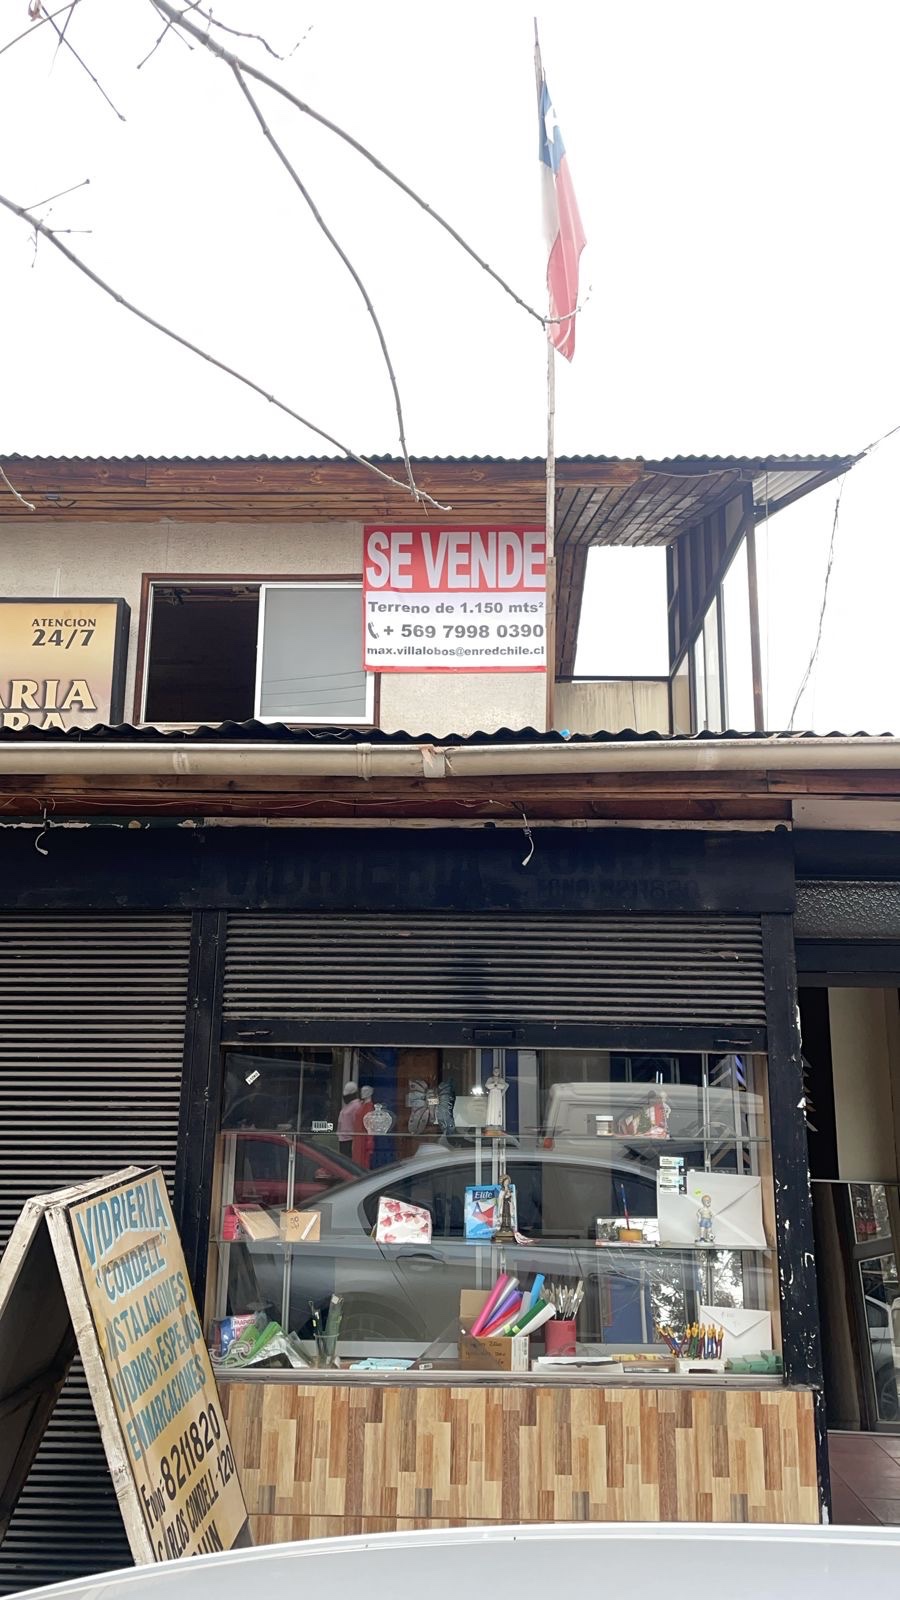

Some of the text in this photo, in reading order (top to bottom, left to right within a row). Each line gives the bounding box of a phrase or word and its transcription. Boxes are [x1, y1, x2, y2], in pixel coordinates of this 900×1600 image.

[366, 531, 546, 589] SE VENDE
[31, 618, 97, 627] ATENCION
[368, 601, 430, 613] Terreno
[435, 602, 454, 613] de
[460, 602, 503, 614] 1.150
[401, 624, 436, 638] 569
[443, 624, 490, 638] 7998
[496, 624, 544, 638] 0390
[31, 628, 95, 649] 24/7
[367, 646, 544, 656] max.villalobos@enredchile.cl
[75, 1178, 170, 1267] VIDRIERIA
[104, 1271, 188, 1361] INSTALACIONES
[111, 1347, 157, 1412] VIDRIOS
[156, 1310, 201, 1371] ESPEJOS
[126, 1358, 207, 1461] ENMARCACIONES
[160, 1402, 221, 1501] 8211820
[186, 1468, 219, 1533] CONDELL
